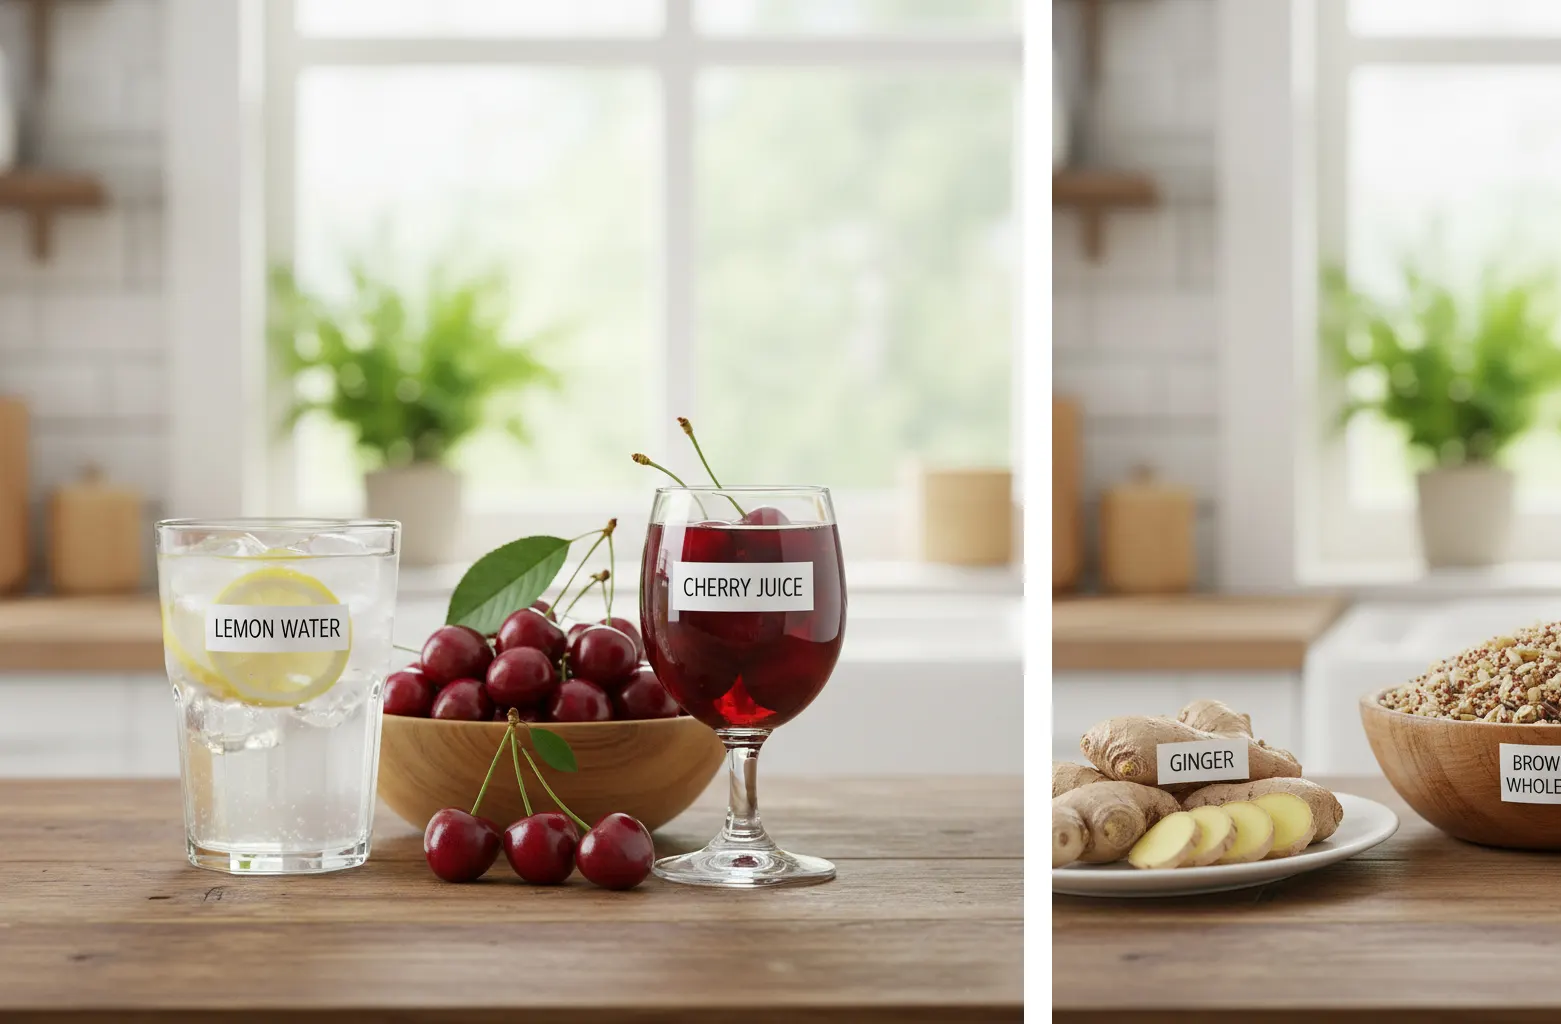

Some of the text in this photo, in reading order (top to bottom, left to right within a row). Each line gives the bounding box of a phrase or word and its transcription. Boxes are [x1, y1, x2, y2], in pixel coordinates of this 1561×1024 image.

[683, 577, 803, 597] CHERRY JUICE
[215, 618, 340, 638] LEMON WATER
[1170, 750, 1234, 772] GINGER
